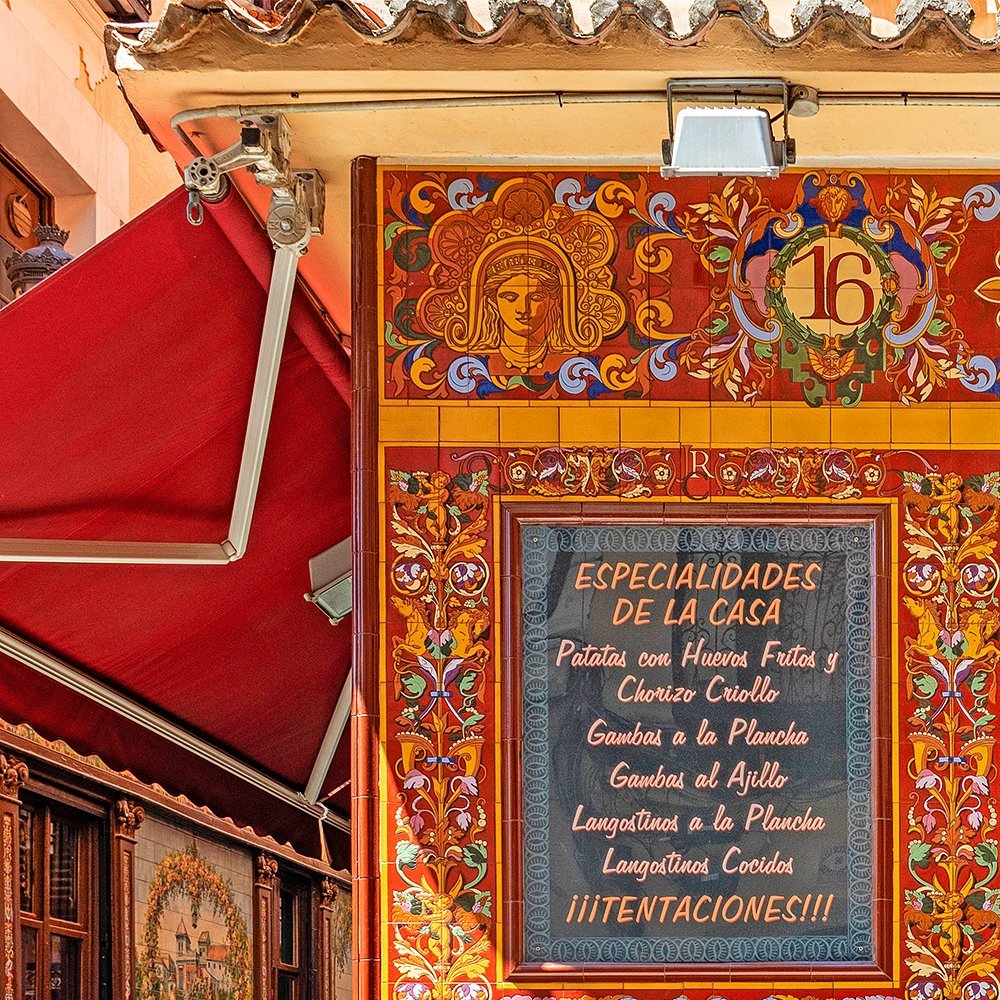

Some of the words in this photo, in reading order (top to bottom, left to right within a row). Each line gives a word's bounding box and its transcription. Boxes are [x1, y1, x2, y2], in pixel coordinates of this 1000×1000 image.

[791, 246, 875, 326] 16
[574, 561, 822, 591] ESPECIALIDADES
[612, 597, 654, 627] DE
[663, 597, 698, 626] LA
[708, 597, 781, 627] CASA
[555, 639, 627, 669] Patatas
[637, 651, 672, 668] con
[681, 637, 748, 669] Huevos
[760, 640, 816, 669] Fritos
[823, 651, 840, 675] y
[617, 674, 697, 704] Chorizo
[705, 674, 780, 704] Criollo
[587, 718, 662, 747] Gambas
[671, 730, 687, 746] a
[695, 718, 718, 746] la
[727, 717, 810, 746] Plancha
[609, 760, 685, 790] Gambas
[694, 760, 720, 789] al
[726, 760, 789, 797] Ajillo
[571, 804, 679, 840] Langostinos
[688, 816, 704, 832] a
[712, 803, 735, 832] la
[744, 803, 827, 832] Plancha
[602, 846, 710, 882] Langostinos
[721, 845, 794, 876] Cocidos
[565, 893, 835, 924] ¡¡¡TENTACIONES!!!
